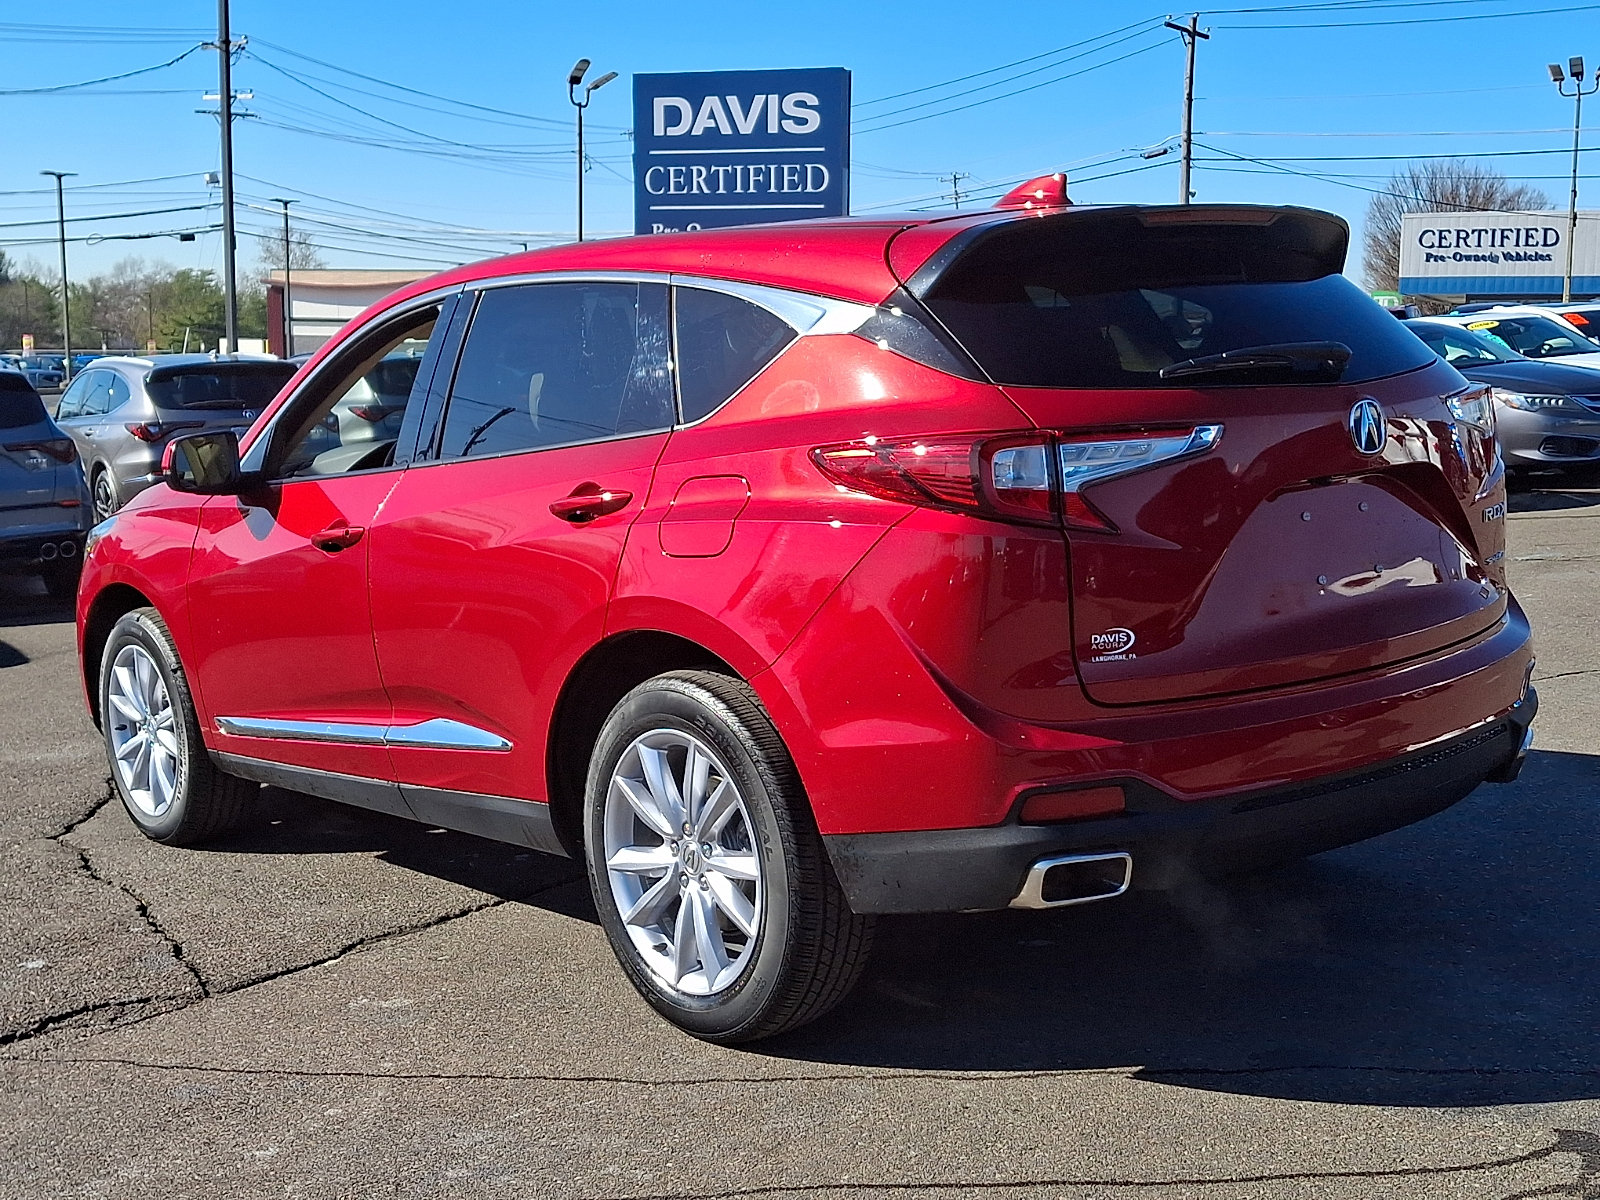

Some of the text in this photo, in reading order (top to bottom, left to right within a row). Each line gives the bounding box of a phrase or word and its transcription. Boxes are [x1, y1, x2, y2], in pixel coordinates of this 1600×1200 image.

[653, 91, 821, 136] DAVIS
[645, 163, 830, 195] CERTIFIED
[1418, 227, 1560, 249] CERTIFIED
[1424, 251, 1553, 264] Pre-Owned Vehicles
[1091, 632, 1127, 643] DAVIS
[1091, 642, 1125, 650] ACURA
